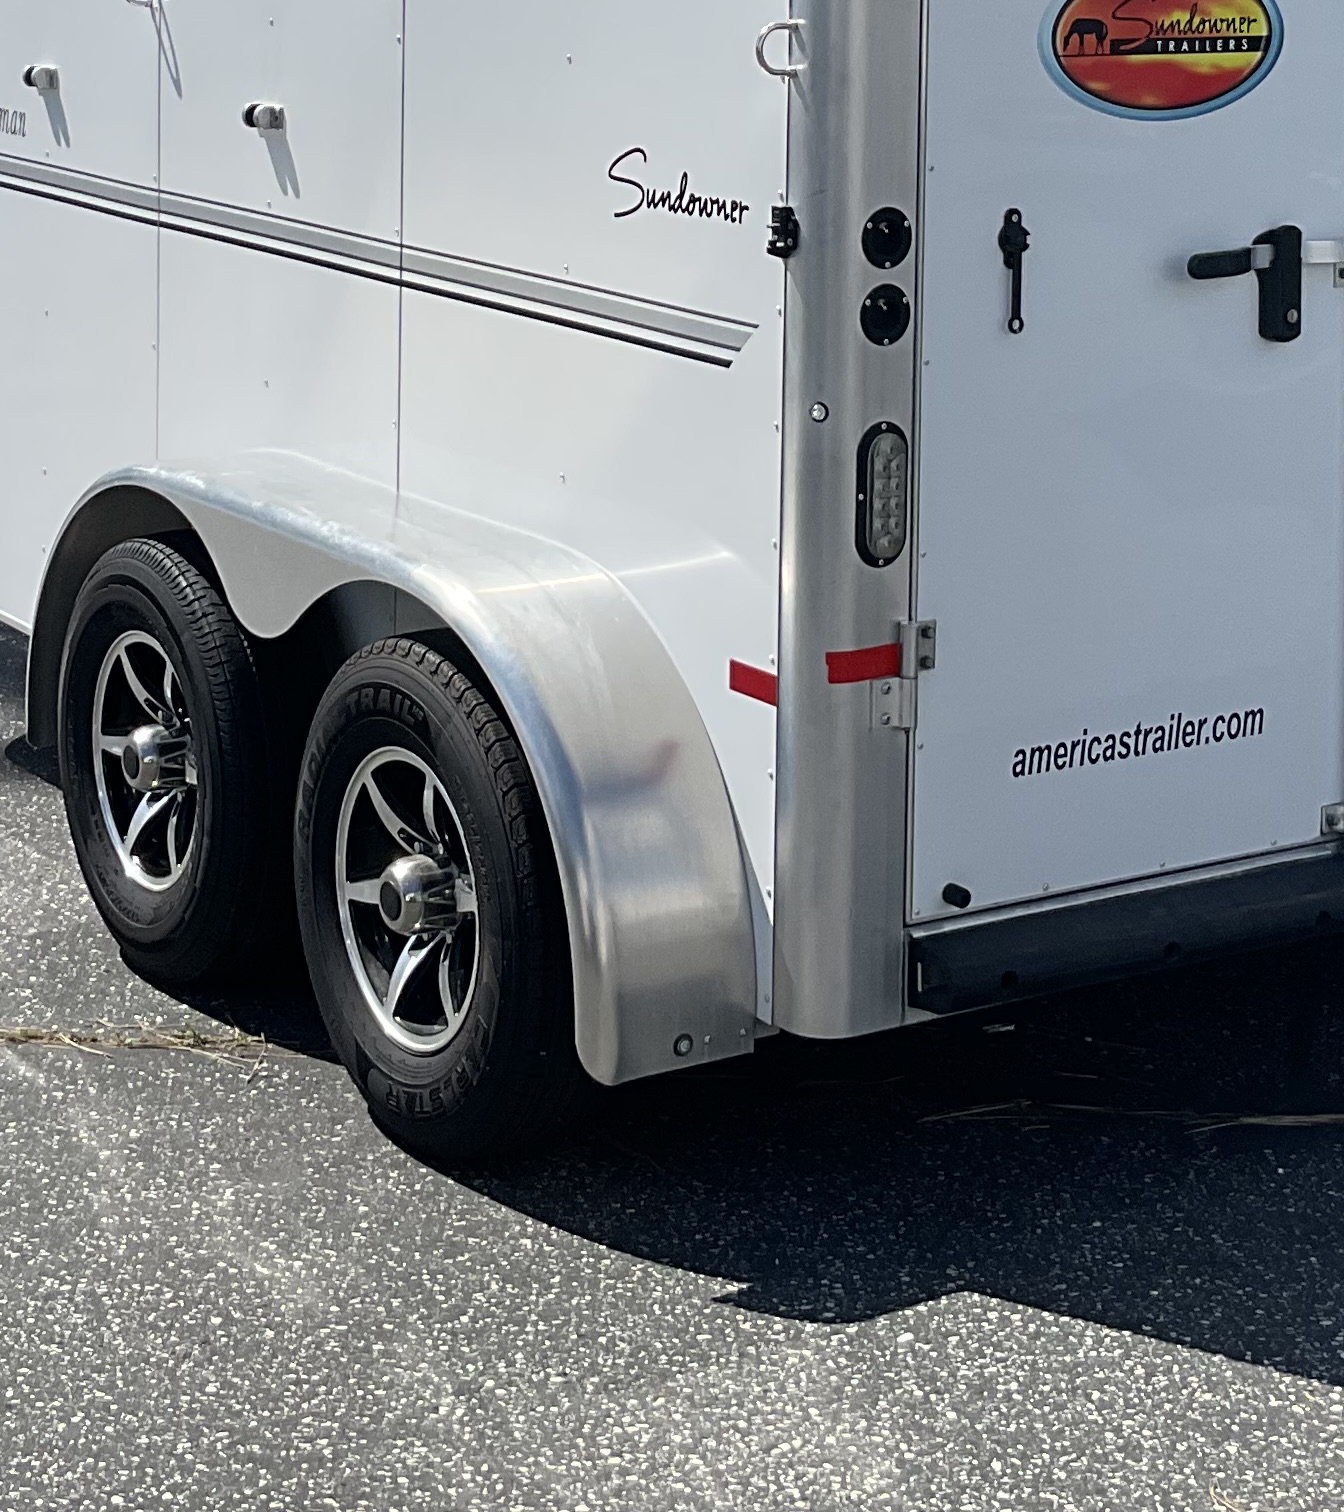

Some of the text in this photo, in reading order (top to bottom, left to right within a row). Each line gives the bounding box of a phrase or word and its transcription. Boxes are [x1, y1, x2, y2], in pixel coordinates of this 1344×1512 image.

[1156, 38, 1249, 53] TRAILERS
[608, 147, 750, 225] Sundowner
[1011, 707, 1265, 778] americastrailer.com
